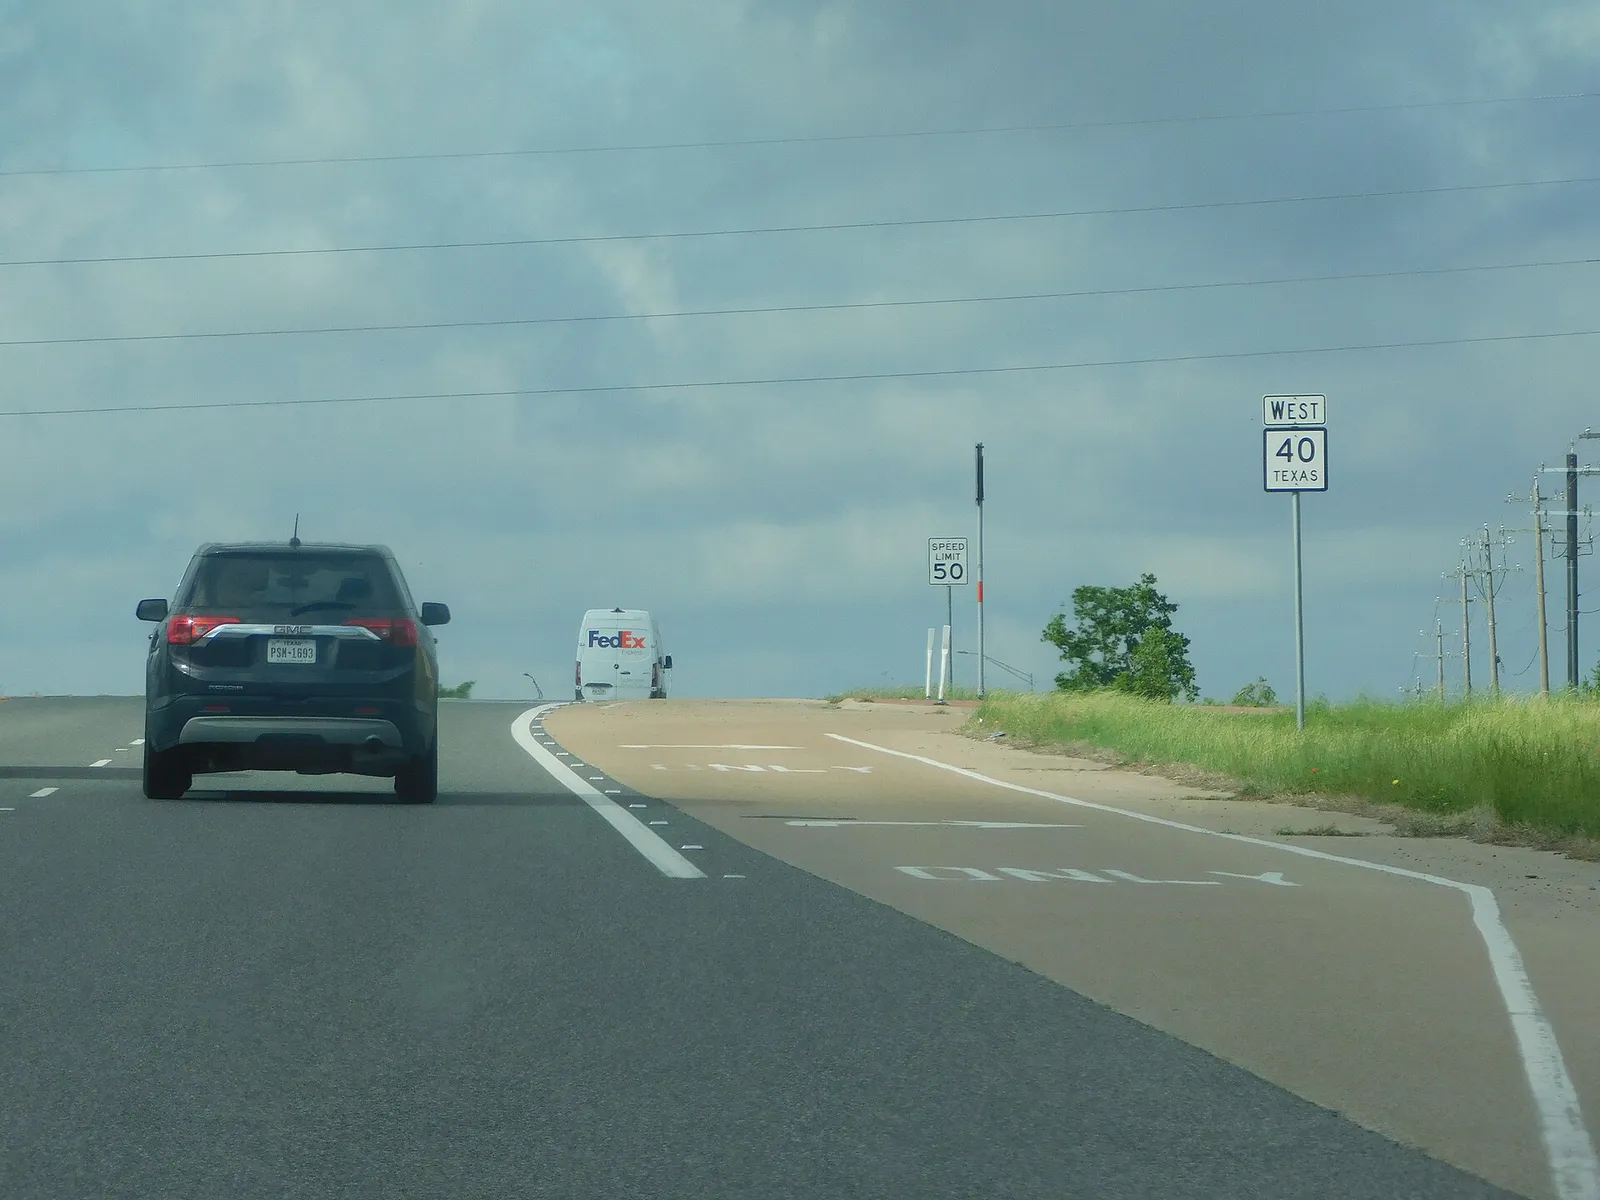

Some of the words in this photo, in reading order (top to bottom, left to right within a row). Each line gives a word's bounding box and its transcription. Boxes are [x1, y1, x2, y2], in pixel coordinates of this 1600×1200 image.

[1270, 400, 1319, 420] WEST
[1275, 437, 1315, 463] 40
[1273, 469, 1318, 482] TEXAS
[931, 542, 965, 551] SPEED
[935, 552, 961, 561] LIMIT
[933, 562, 964, 580] 50
[274, 625, 313, 634] GMC
[588, 630, 646, 649] FedEx
[892, 865, 1302, 887] ONLY
